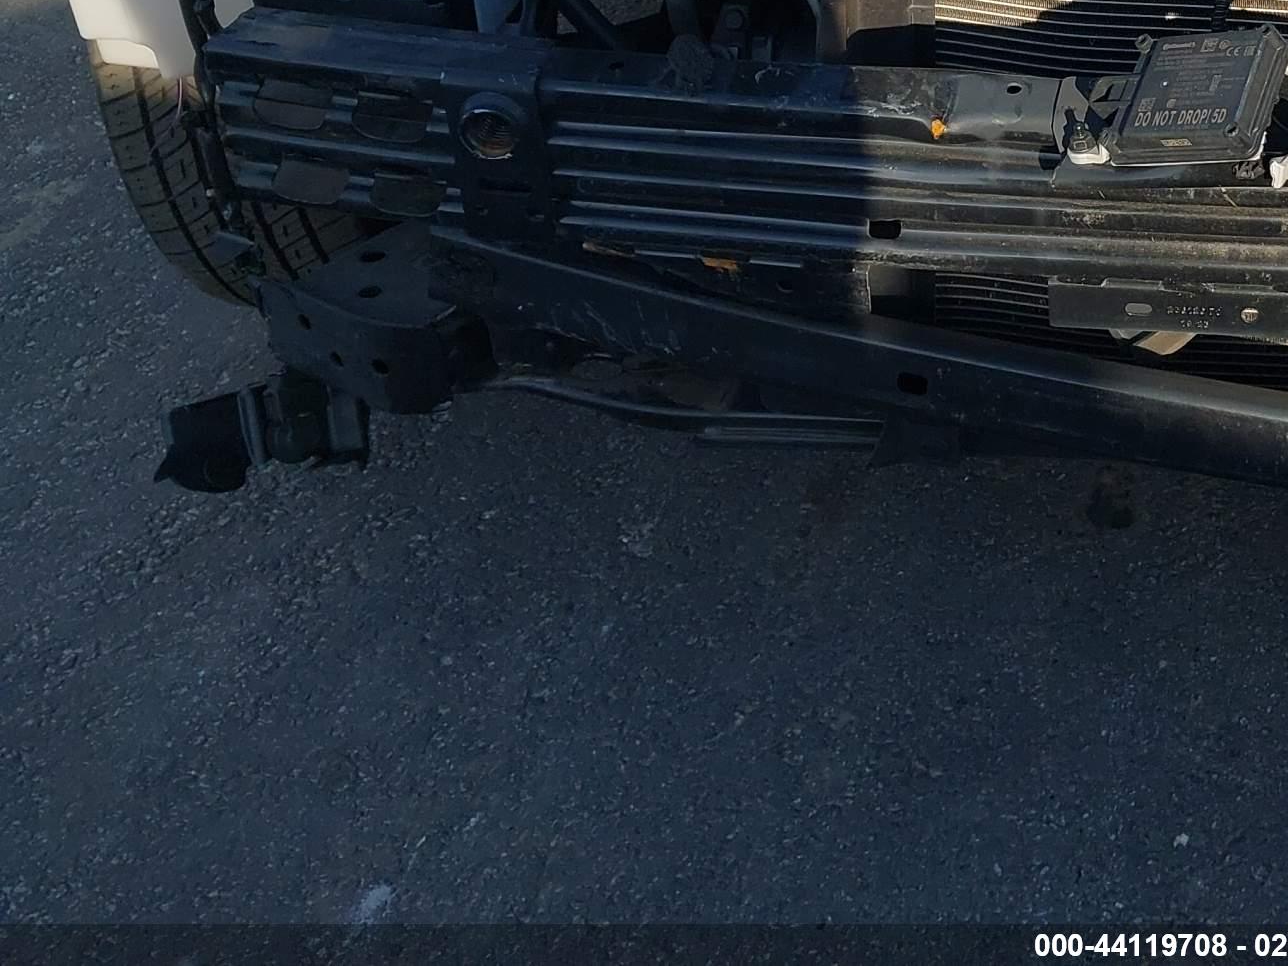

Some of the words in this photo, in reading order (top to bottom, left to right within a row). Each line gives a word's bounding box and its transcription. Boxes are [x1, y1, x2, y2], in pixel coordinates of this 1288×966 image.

[1134, 112, 1152, 127] DO
[1152, 110, 1177, 126] NOT
[1177, 108, 1212, 125] DROP!
[1212, 108, 1227, 123] 5D
